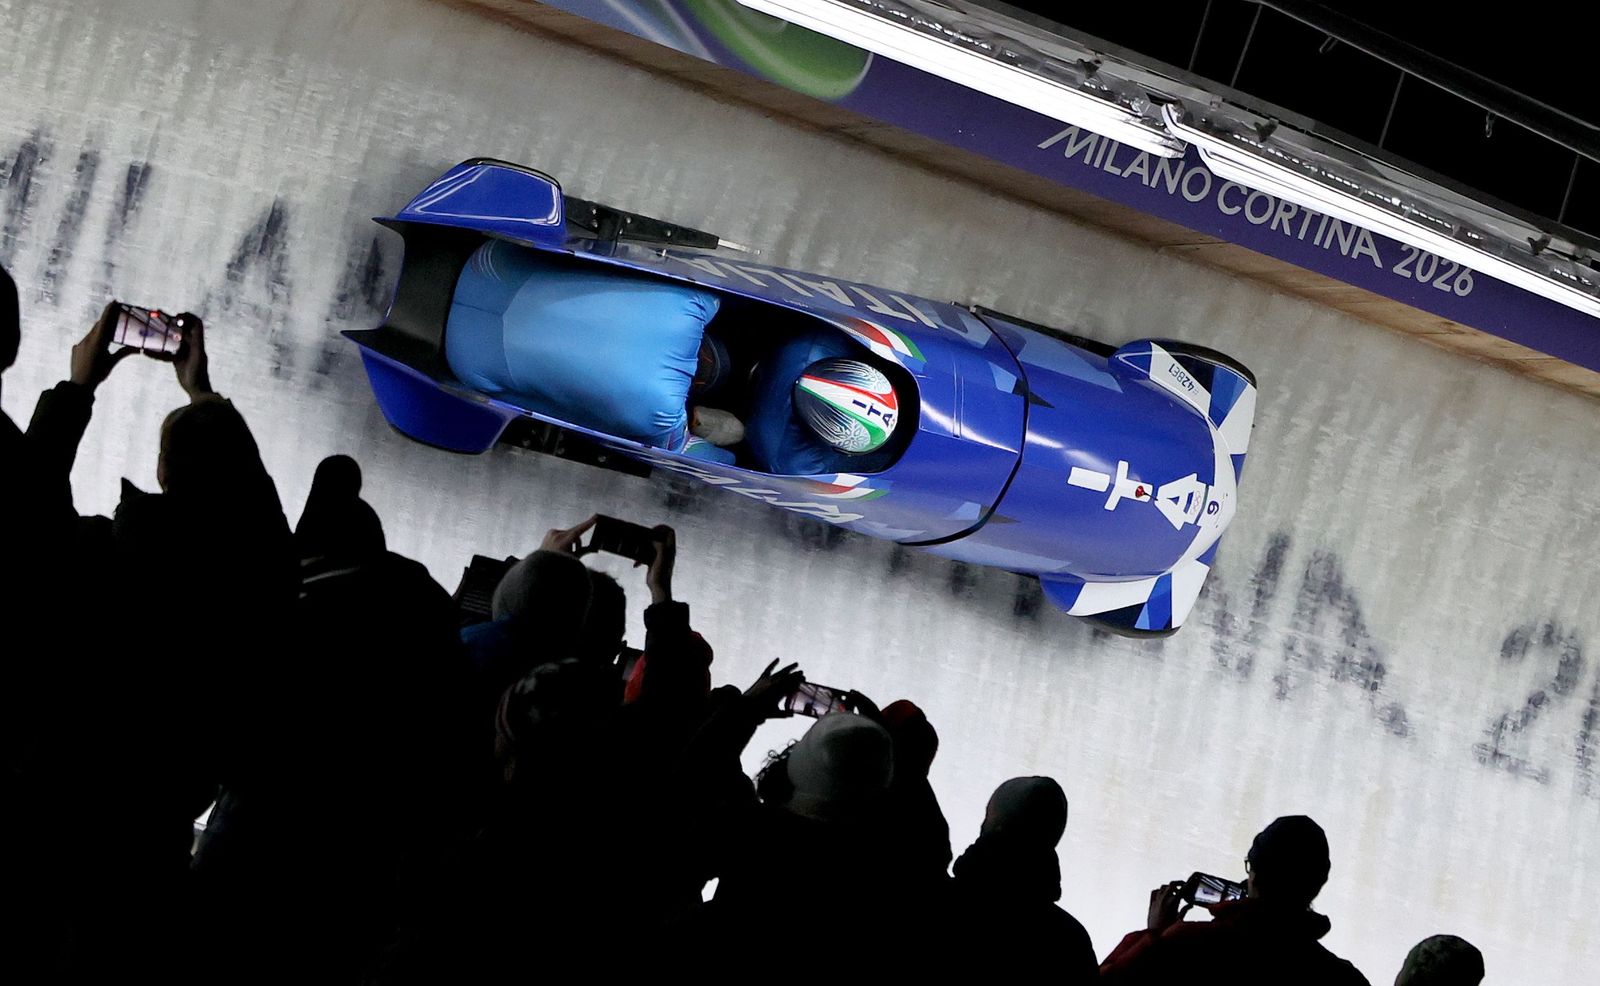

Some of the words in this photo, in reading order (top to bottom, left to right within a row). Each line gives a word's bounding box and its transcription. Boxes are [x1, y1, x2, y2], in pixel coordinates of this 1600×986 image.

[1037, 125, 1211, 203] MILANO
[1217, 182, 1383, 269] CORTINA
[1392, 245, 1475, 298] 2026
[852, 399, 893, 427] ITA
[1066, 459, 1199, 531] ITA
